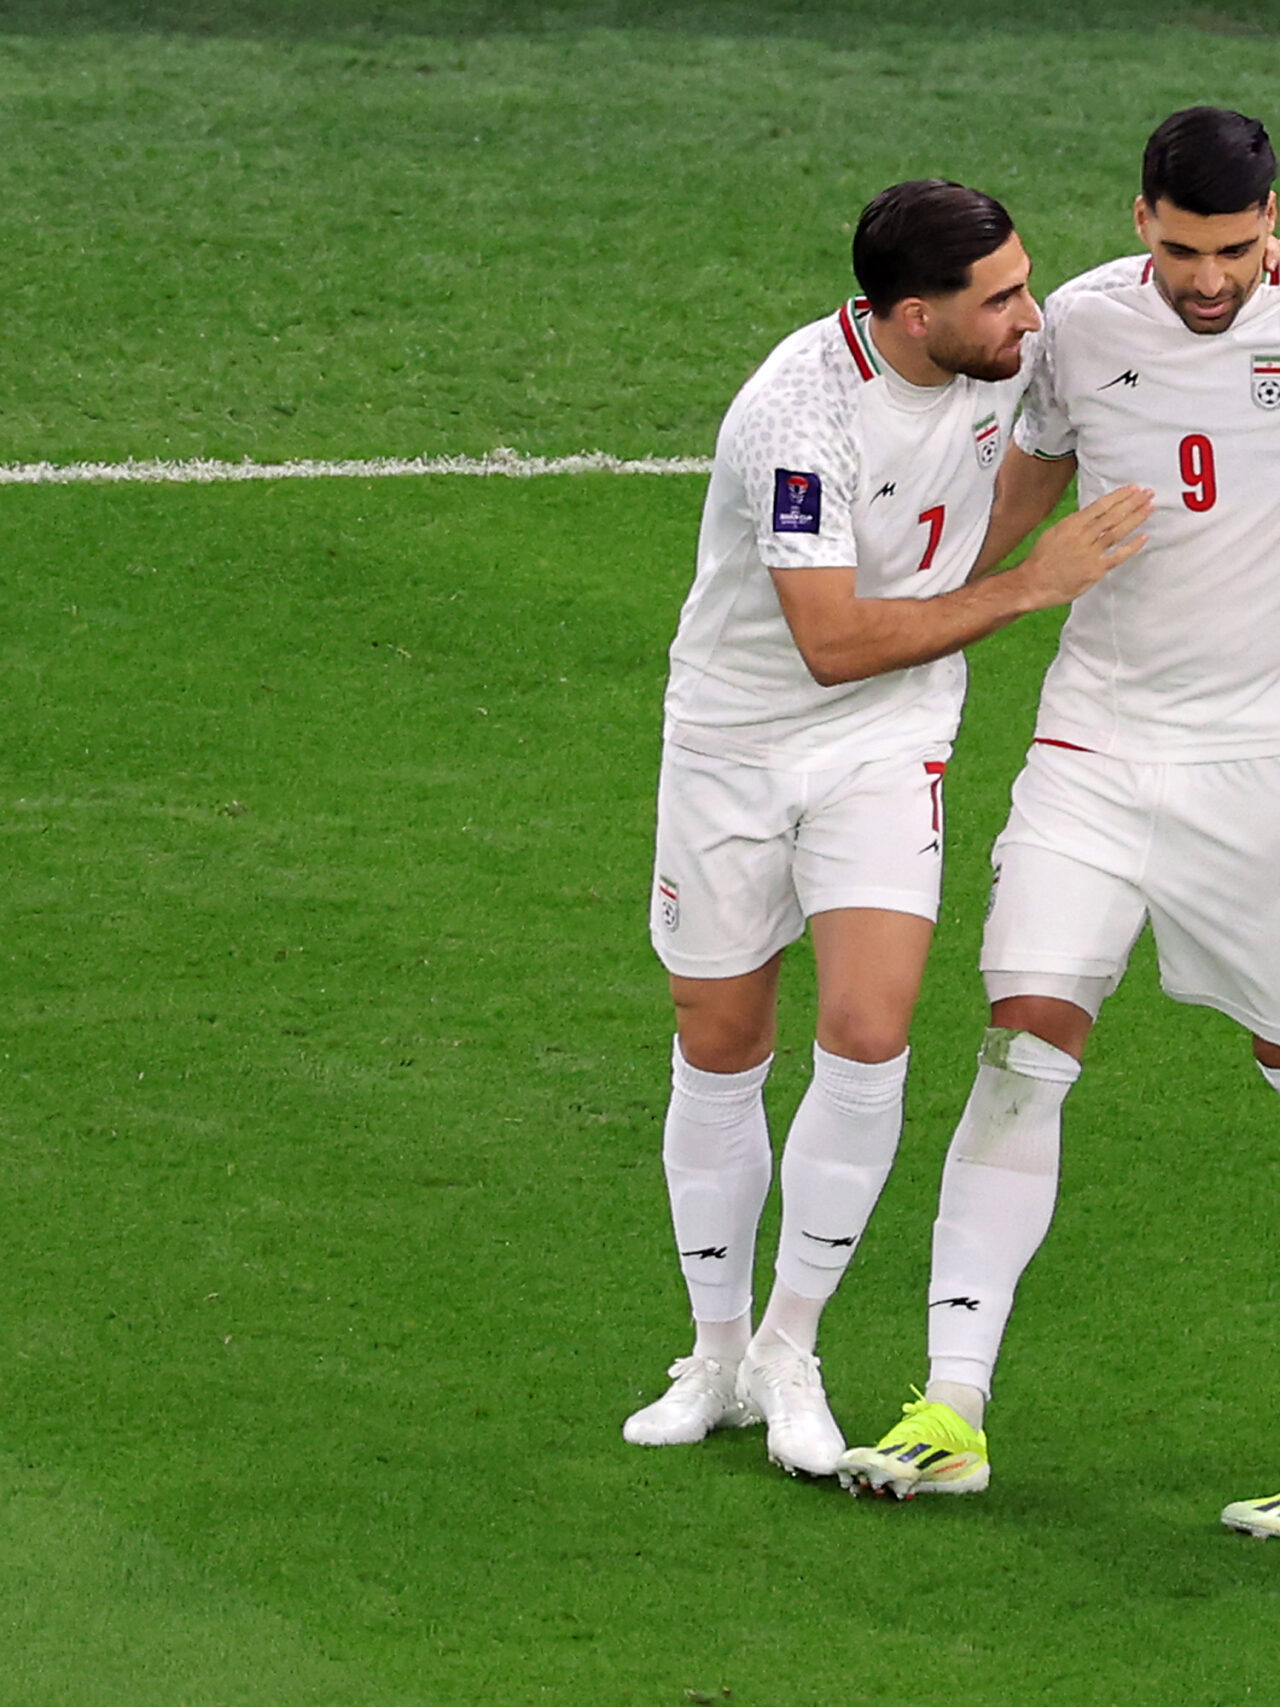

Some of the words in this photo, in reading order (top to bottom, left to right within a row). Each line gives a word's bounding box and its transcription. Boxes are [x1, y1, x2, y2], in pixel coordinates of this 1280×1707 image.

[1179, 433, 1217, 512] 9
[918, 504, 945, 570] 7
[924, 761, 947, 831] 7
